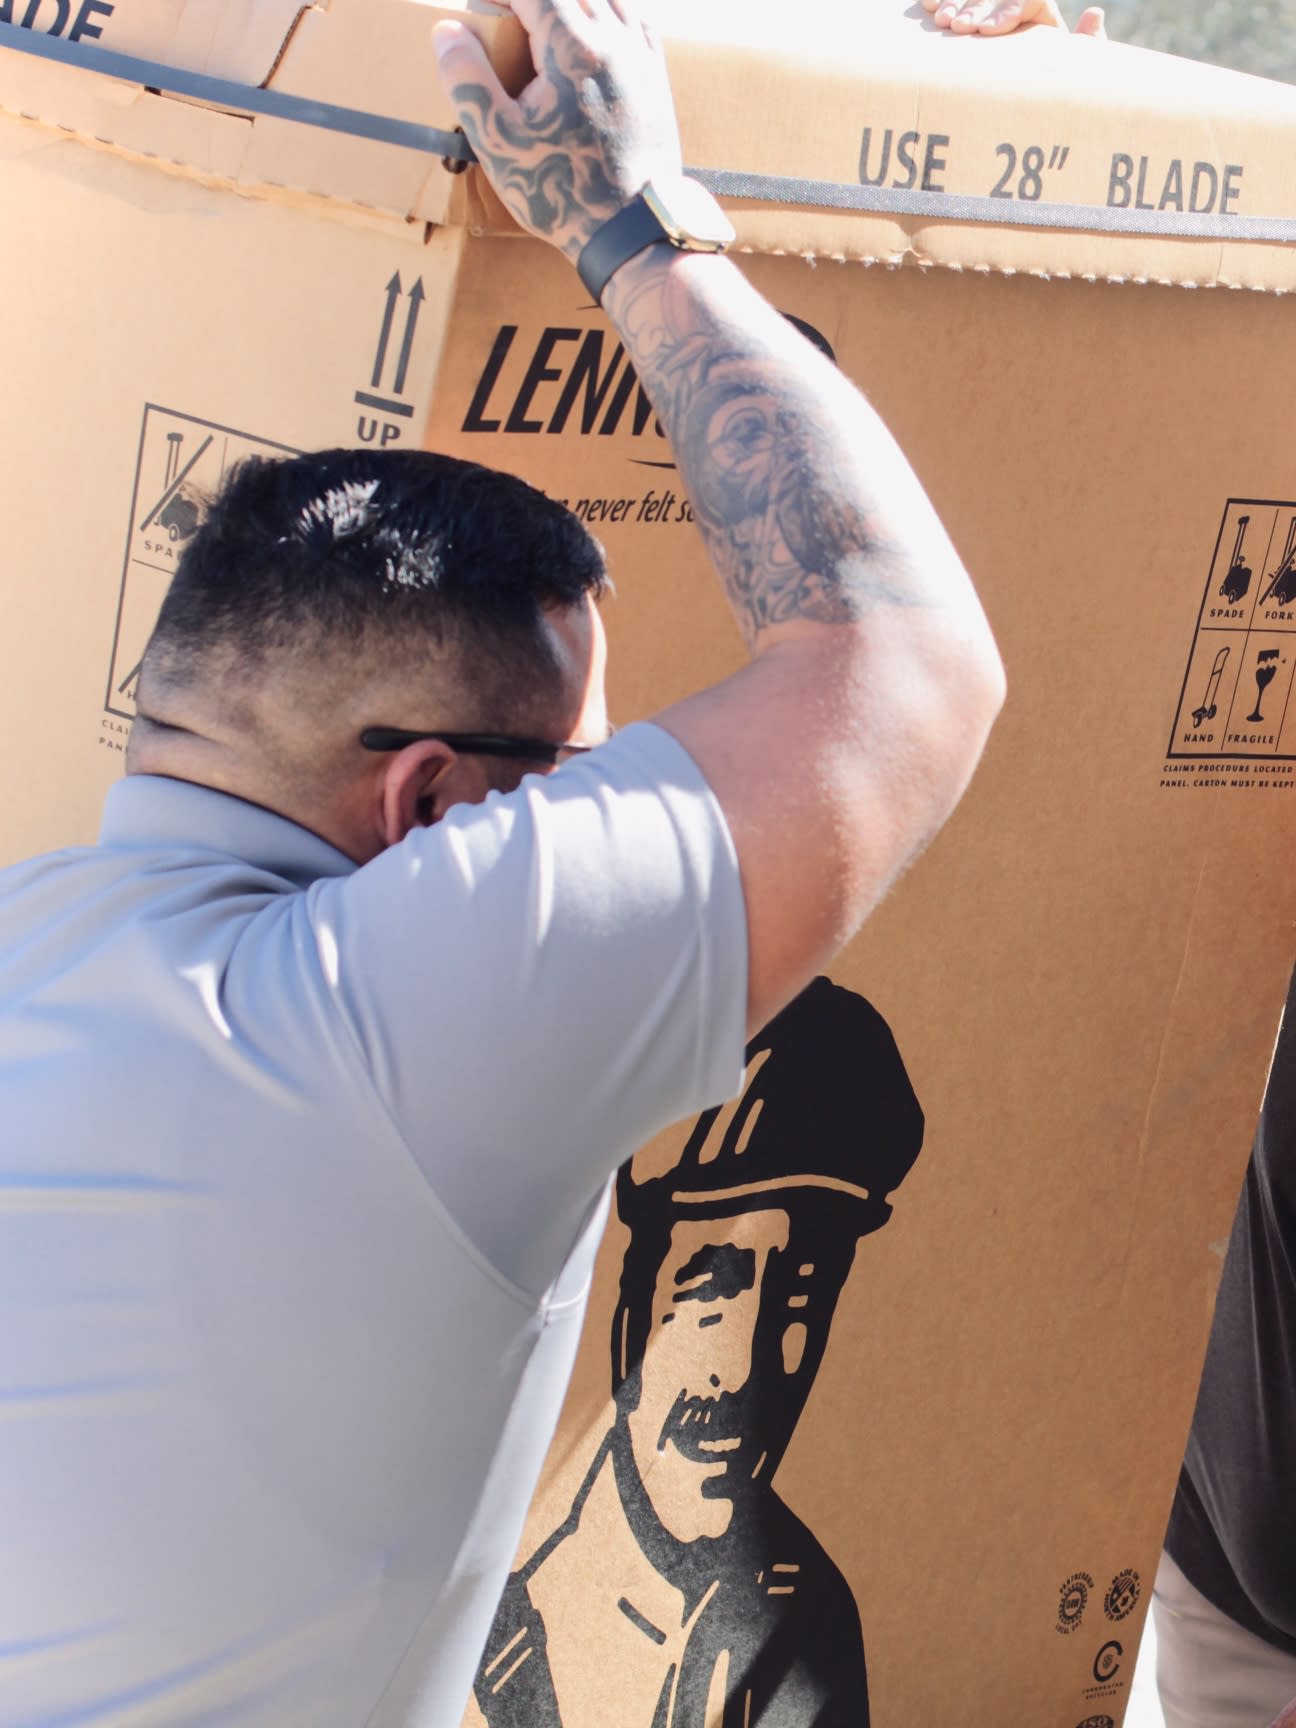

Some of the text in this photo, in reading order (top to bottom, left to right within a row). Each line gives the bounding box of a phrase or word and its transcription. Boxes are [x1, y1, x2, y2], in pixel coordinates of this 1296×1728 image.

[858, 127, 1244, 216] USE 28" BLADE
[461, 325, 666, 439] LENN
[357, 415, 402, 447] UP
[575, 498, 636, 523] never
[636, 490, 677, 523] felt
[144, 540, 183, 560] SPA
[1209, 608, 1245, 619] SPADE
[1264, 610, 1294, 620] FORK
[101, 718, 129, 736] CLAI
[99, 736, 128, 752] PAN
[1183, 733, 1275, 745] HAND FRAGILE
[1163, 764, 1195, 773] CLAIMS
[1198, 764, 1250, 773] PROCEDURE
[1253, 766, 1293, 774] LOCATED
[1160, 780, 1190, 788] PANEL.
[1193, 779, 1227, 788] CARTON
[1230, 780, 1255, 788] MUST
[1258, 780, 1269, 788] BE
[1272, 780, 1295, 789] KEPT
